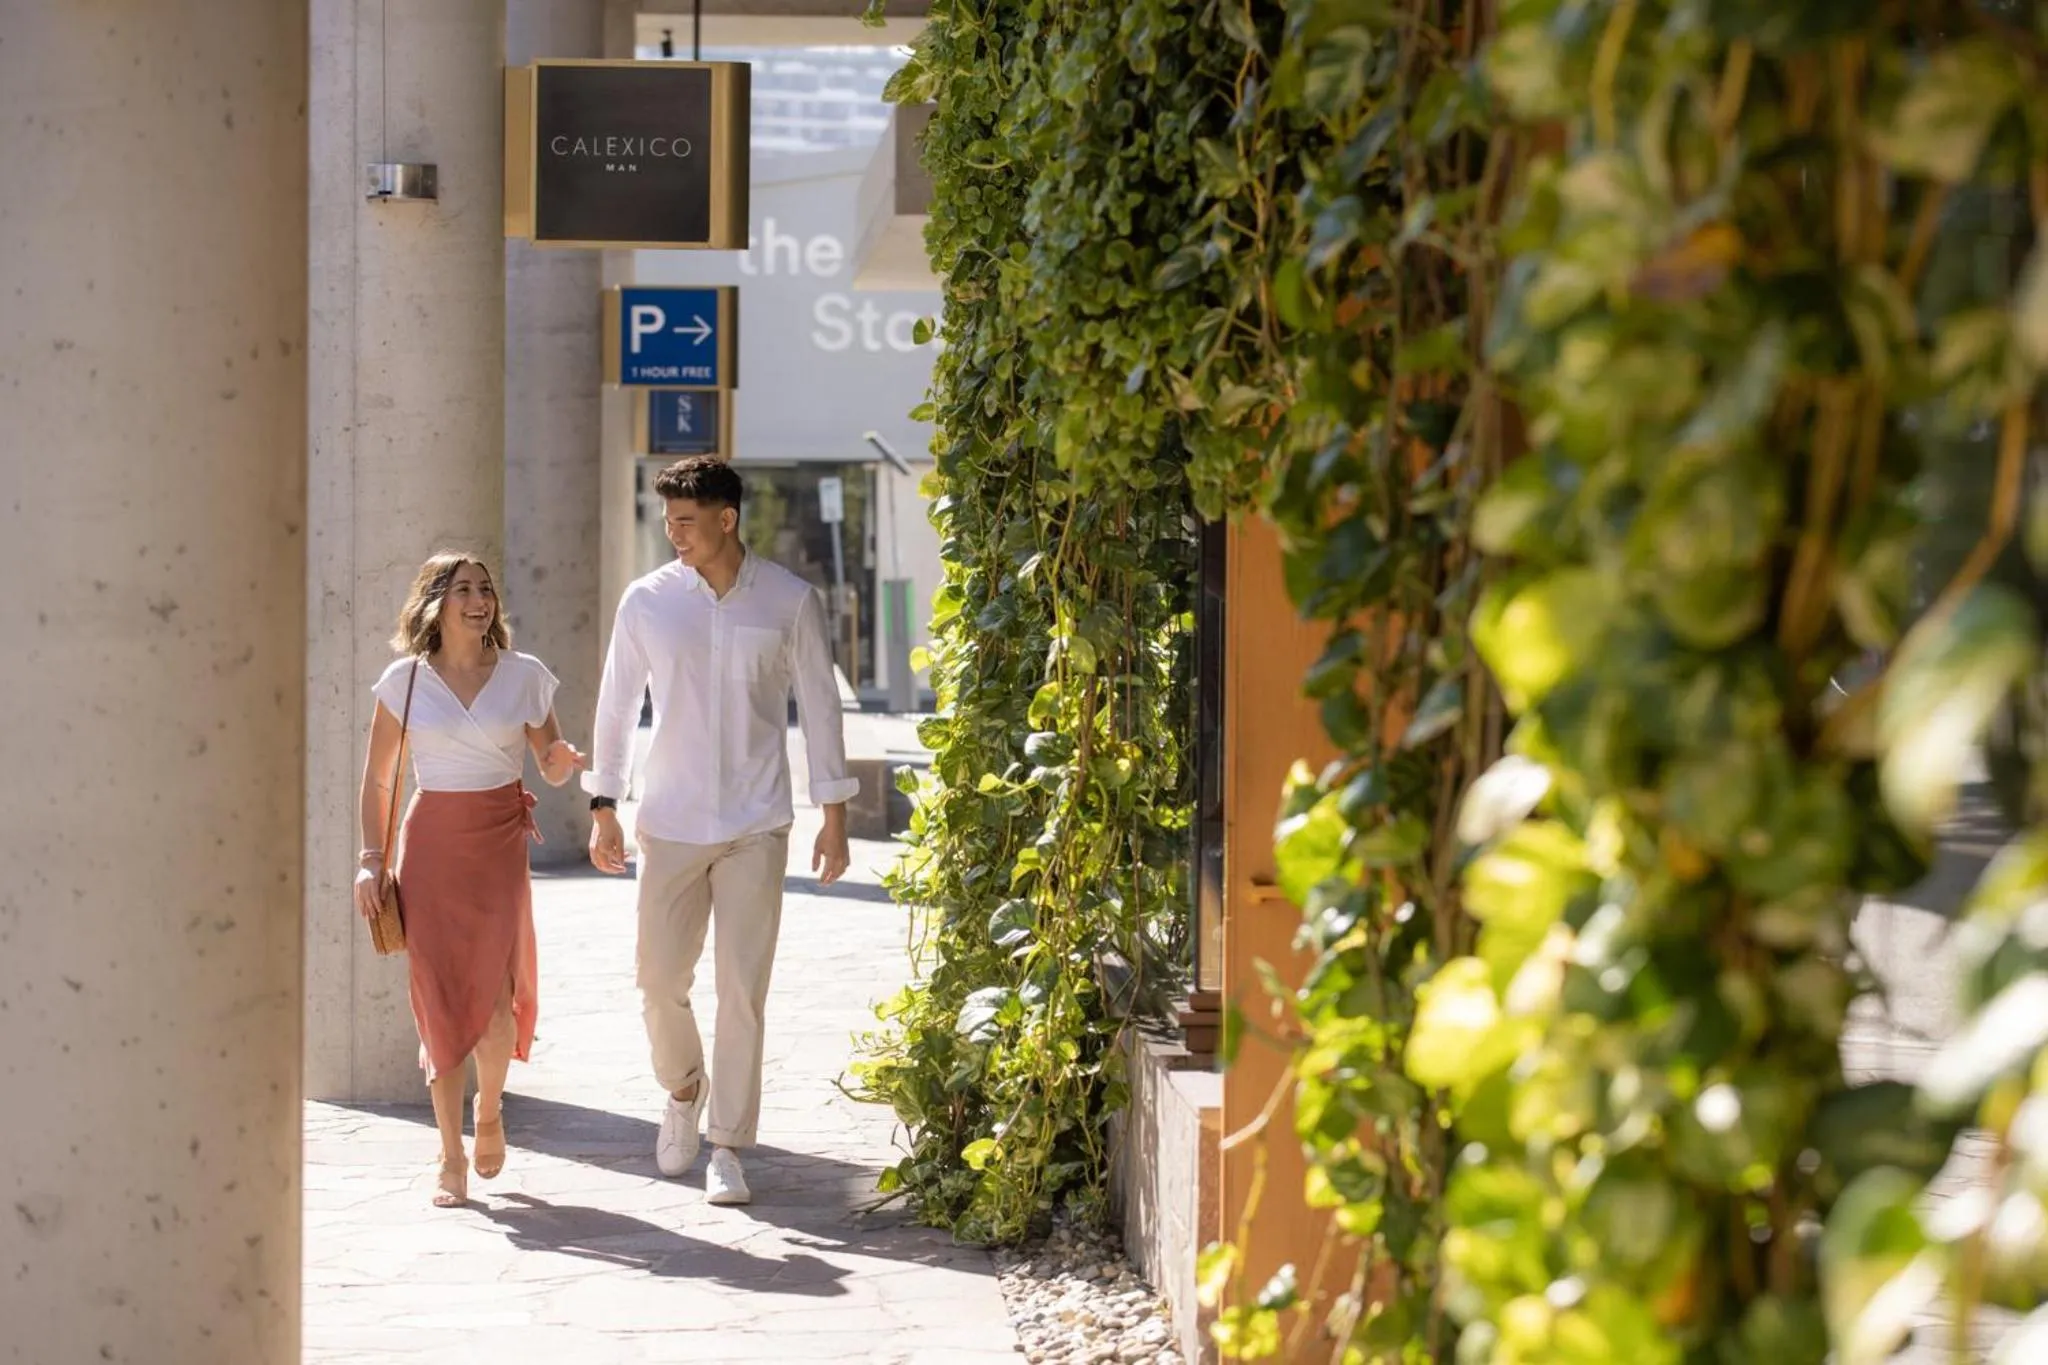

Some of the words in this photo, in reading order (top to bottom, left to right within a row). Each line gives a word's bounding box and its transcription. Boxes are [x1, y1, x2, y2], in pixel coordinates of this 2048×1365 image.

[551, 135, 692, 157] CALEXICO
[605, 163, 637, 172] MAN
[630, 304, 666, 354] P
[631, 366, 638, 378] 1
[640, 366, 679, 379] HOUR
[681, 366, 712, 378] FREE
